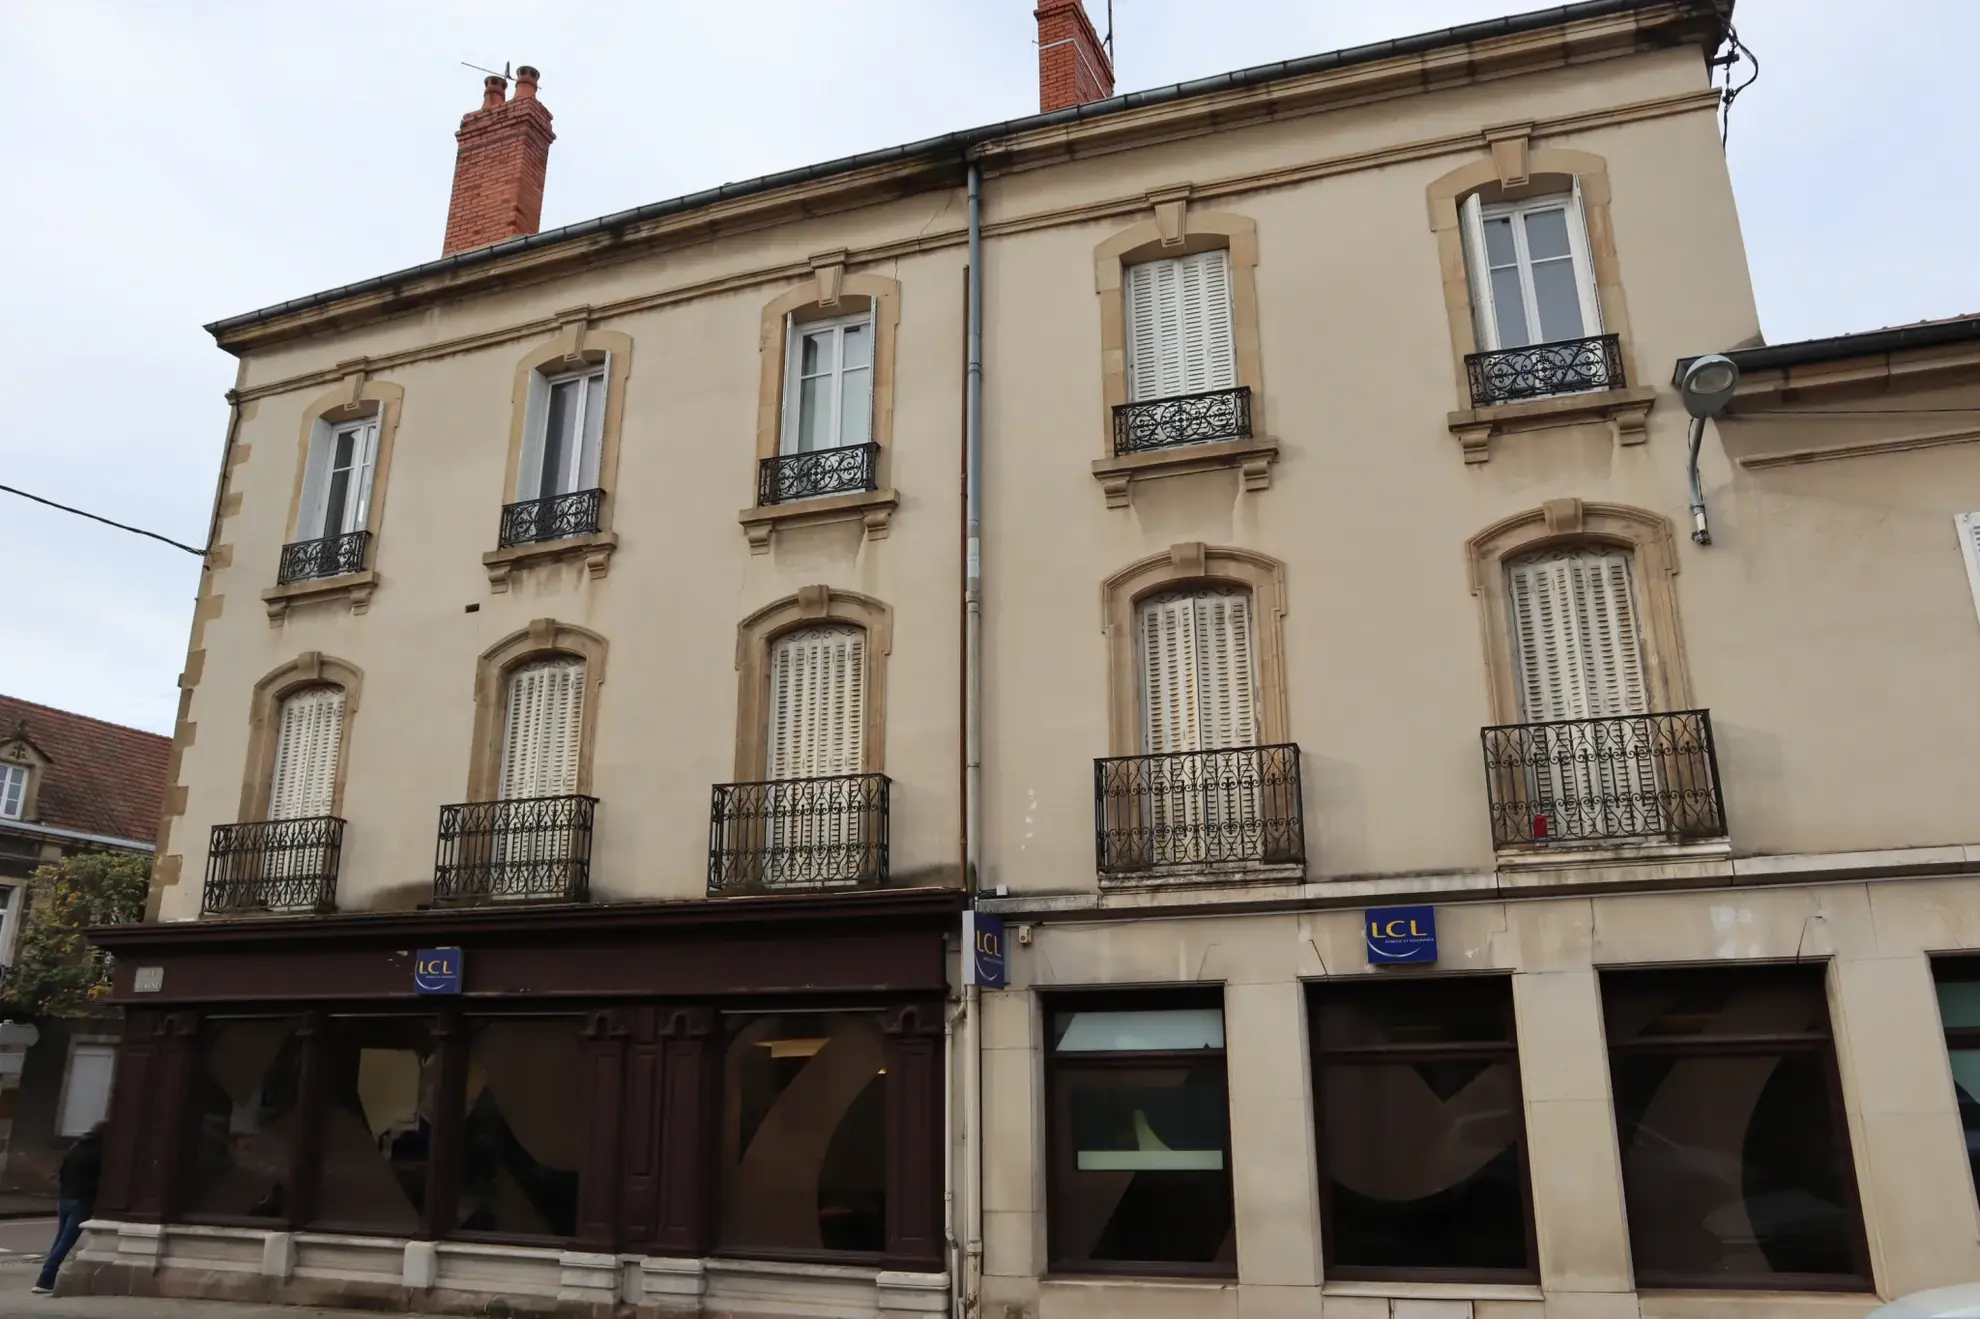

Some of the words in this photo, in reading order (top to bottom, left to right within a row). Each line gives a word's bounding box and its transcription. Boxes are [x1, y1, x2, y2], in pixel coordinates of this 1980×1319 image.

[1371, 920, 1428, 938] LCL
[976, 929, 1002, 958] LCL
[419, 960, 453, 975] LCL
